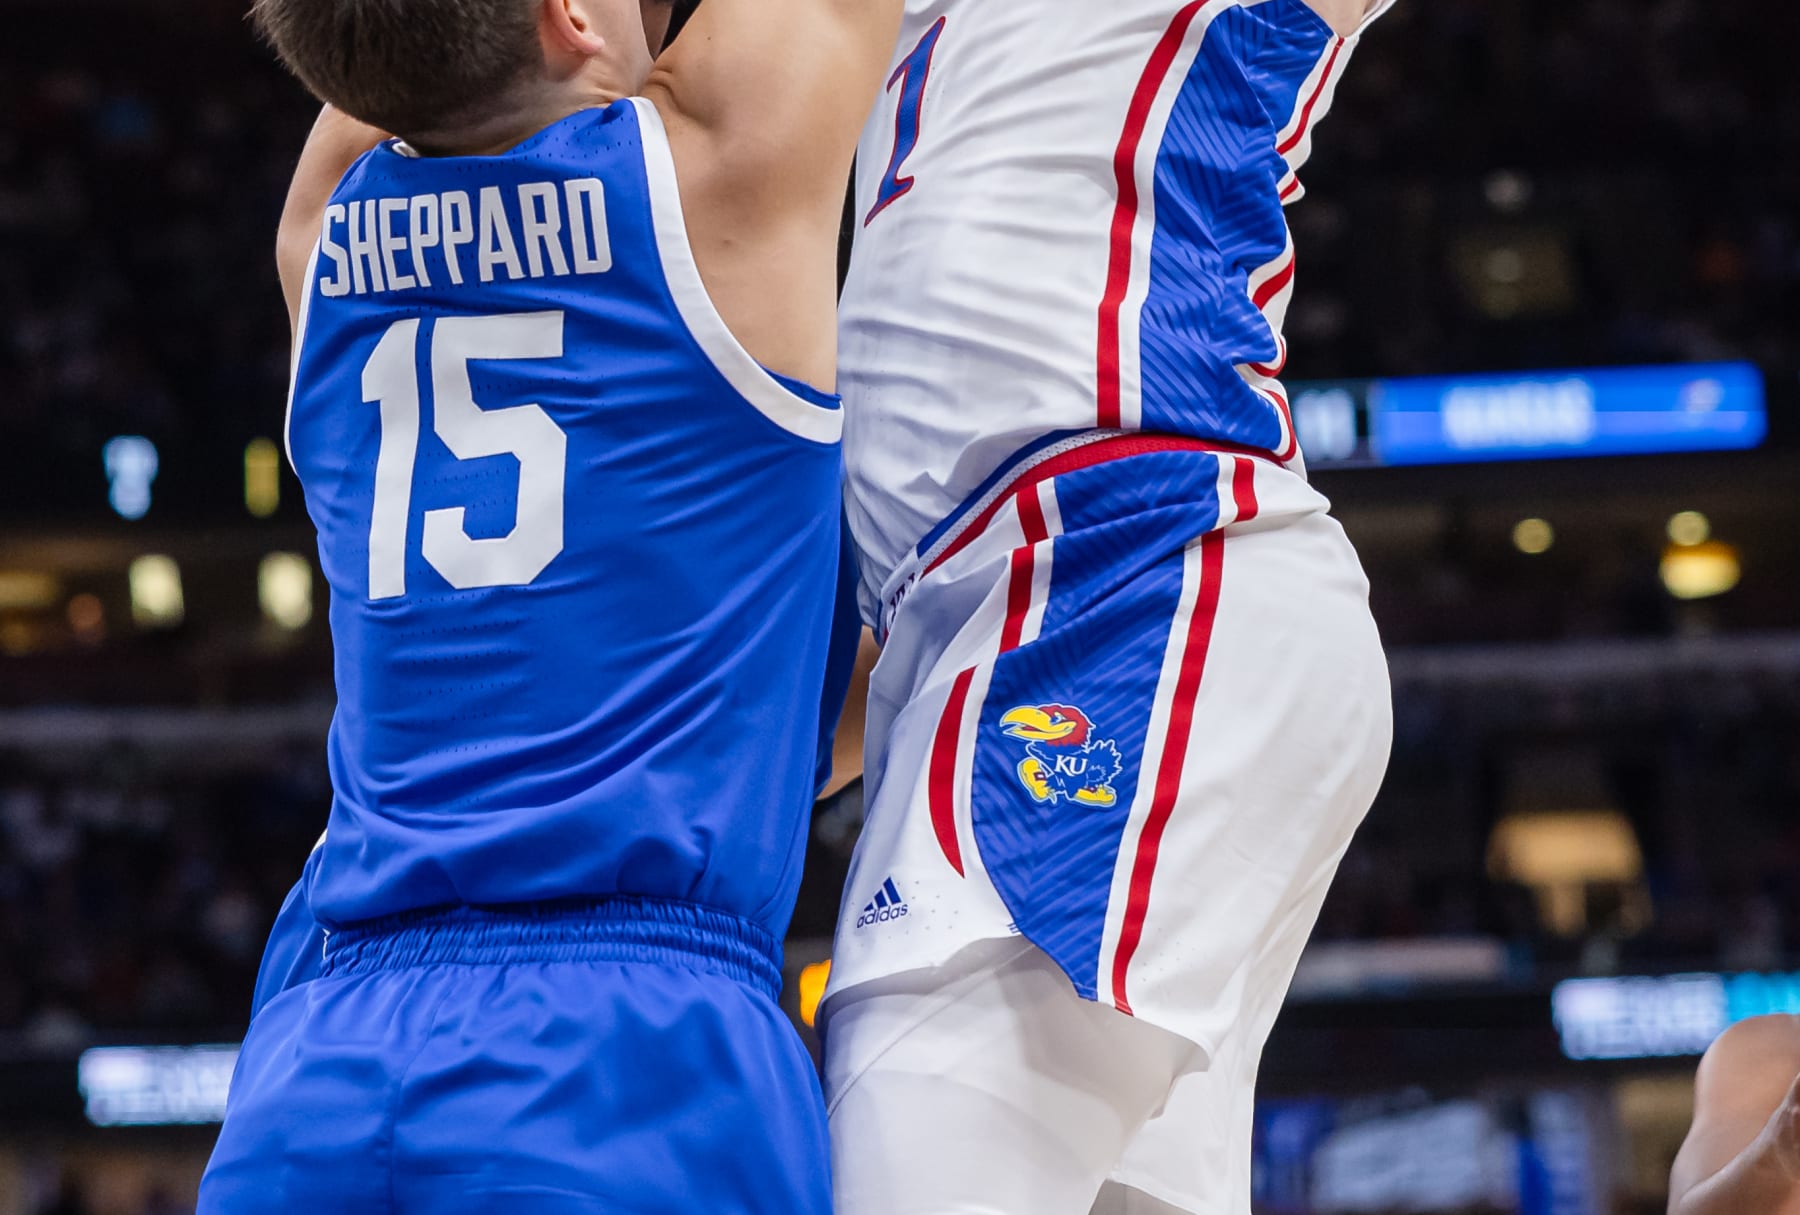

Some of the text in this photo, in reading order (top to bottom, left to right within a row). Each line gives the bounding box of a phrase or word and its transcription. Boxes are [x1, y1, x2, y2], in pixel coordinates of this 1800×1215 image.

[864, 15, 946, 228] 1
[320, 177, 612, 297] SHEPPARD
[361, 310, 567, 600] 15
[1054, 754, 1088, 777] KU
[857, 903, 908, 928] adidas
